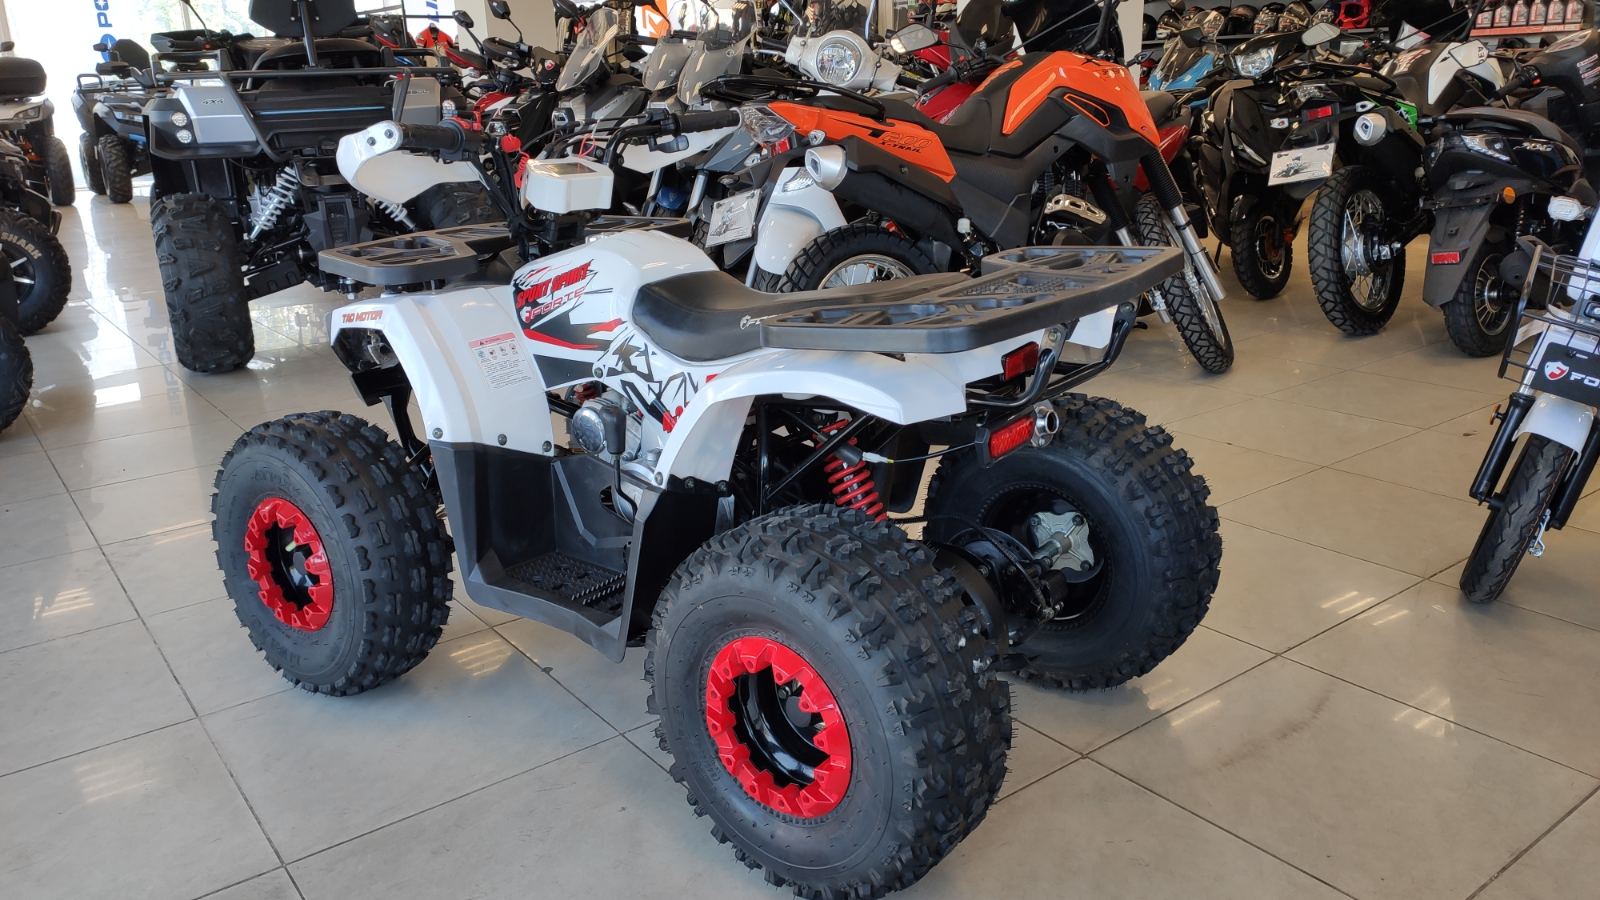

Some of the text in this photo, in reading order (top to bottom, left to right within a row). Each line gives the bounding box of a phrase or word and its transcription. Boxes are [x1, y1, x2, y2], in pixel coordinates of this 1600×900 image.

[1, 231, 42, 260] SHARK
[530, 286, 586, 320] FORTE
[355, 310, 384, 322] MOTOR
[1570, 371, 1600, 389] FO
